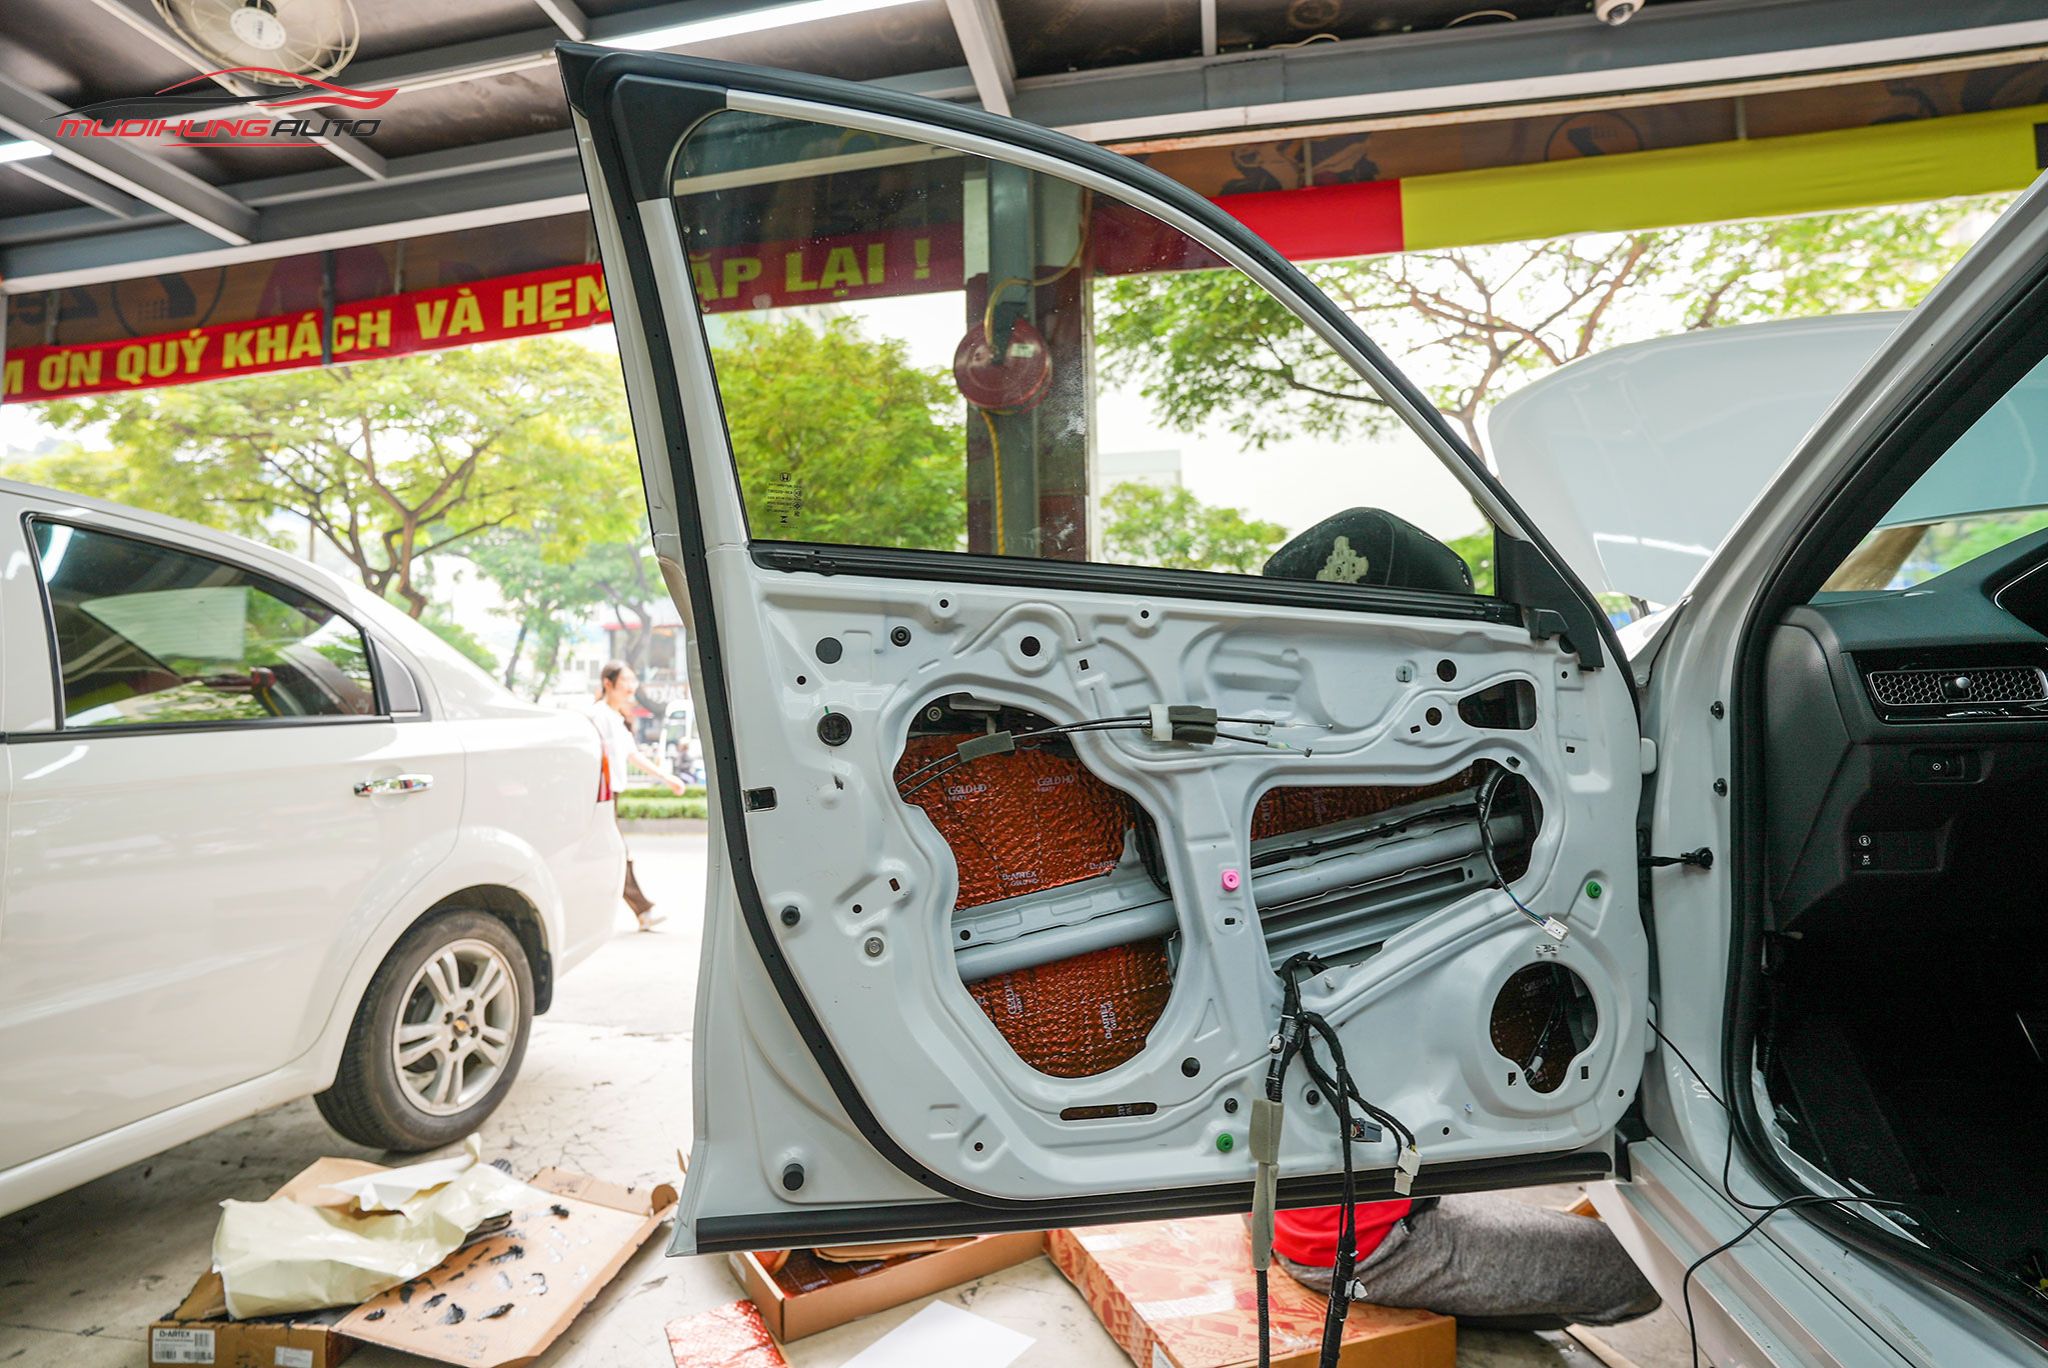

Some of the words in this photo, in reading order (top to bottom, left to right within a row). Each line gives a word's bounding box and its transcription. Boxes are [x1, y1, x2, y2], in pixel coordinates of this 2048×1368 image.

[38, 349, 103, 391] ƠN
[116, 328, 209, 385] QUÝ
[222, 309, 391, 369] KHÁCH
[415, 287, 485, 340] VÀ
[503, 273, 611, 331] HẸN
[784, 243, 886, 297] LẠI
[948, 785, 972, 796] GOLD
